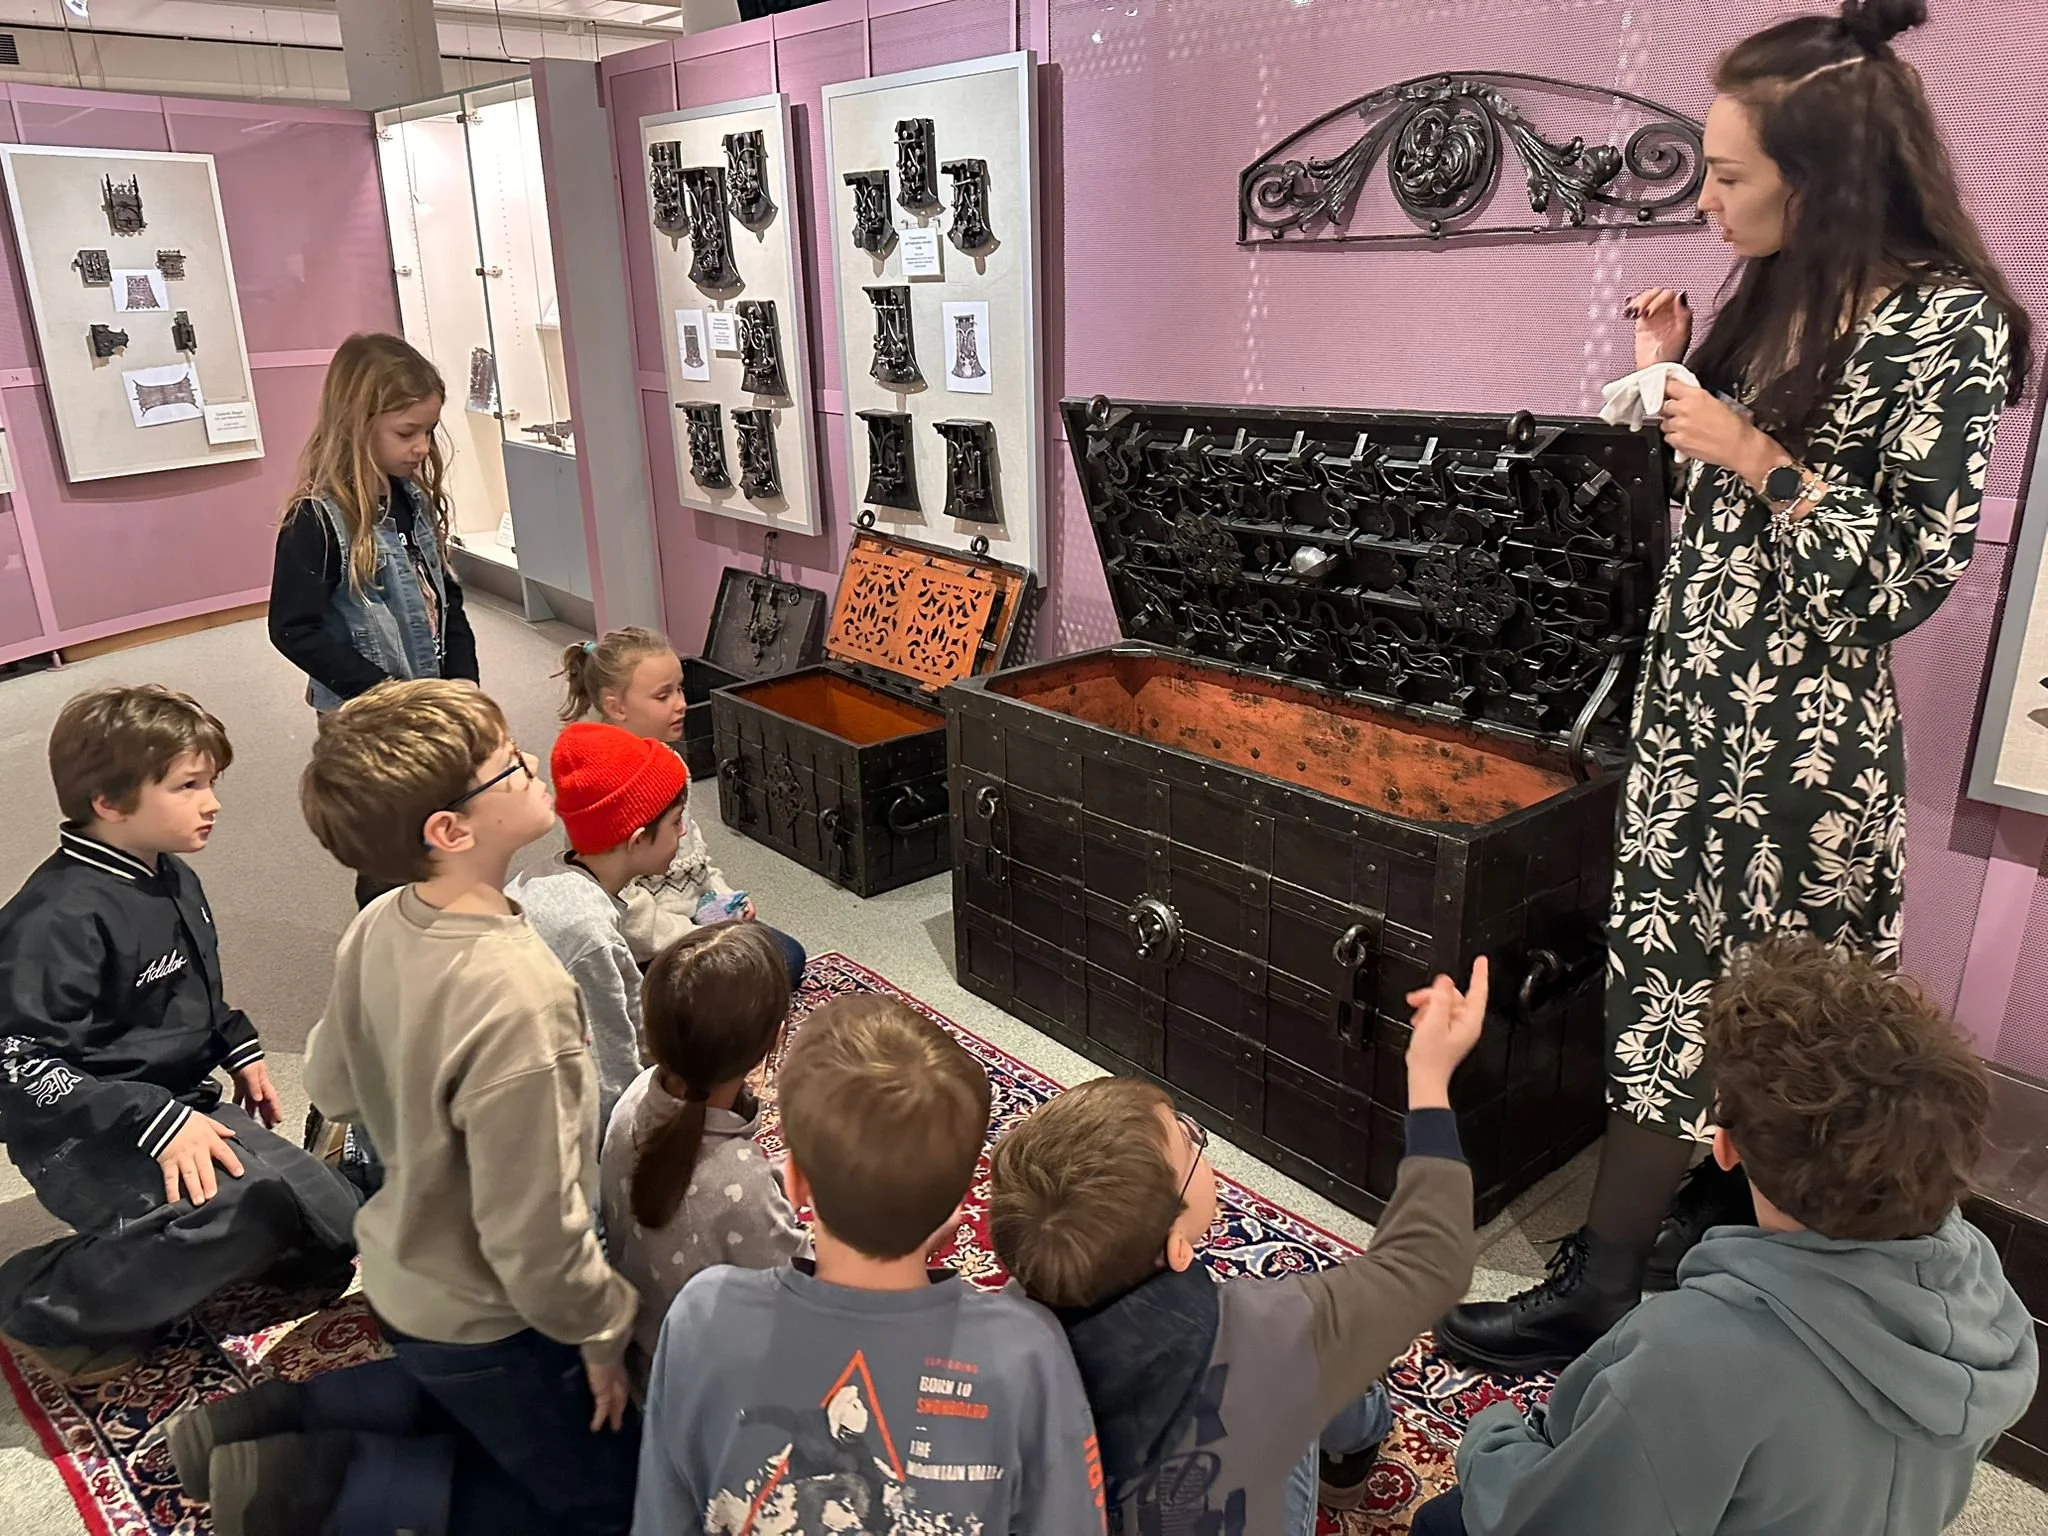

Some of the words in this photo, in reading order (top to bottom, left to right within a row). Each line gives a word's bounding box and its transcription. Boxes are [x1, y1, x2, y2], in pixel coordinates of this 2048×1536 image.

[136, 949, 187, 987] Adidas
[919, 1375, 955, 1395] BORN
[956, 1381, 973, 1397] TO
[909, 1440, 932, 1459] THE
